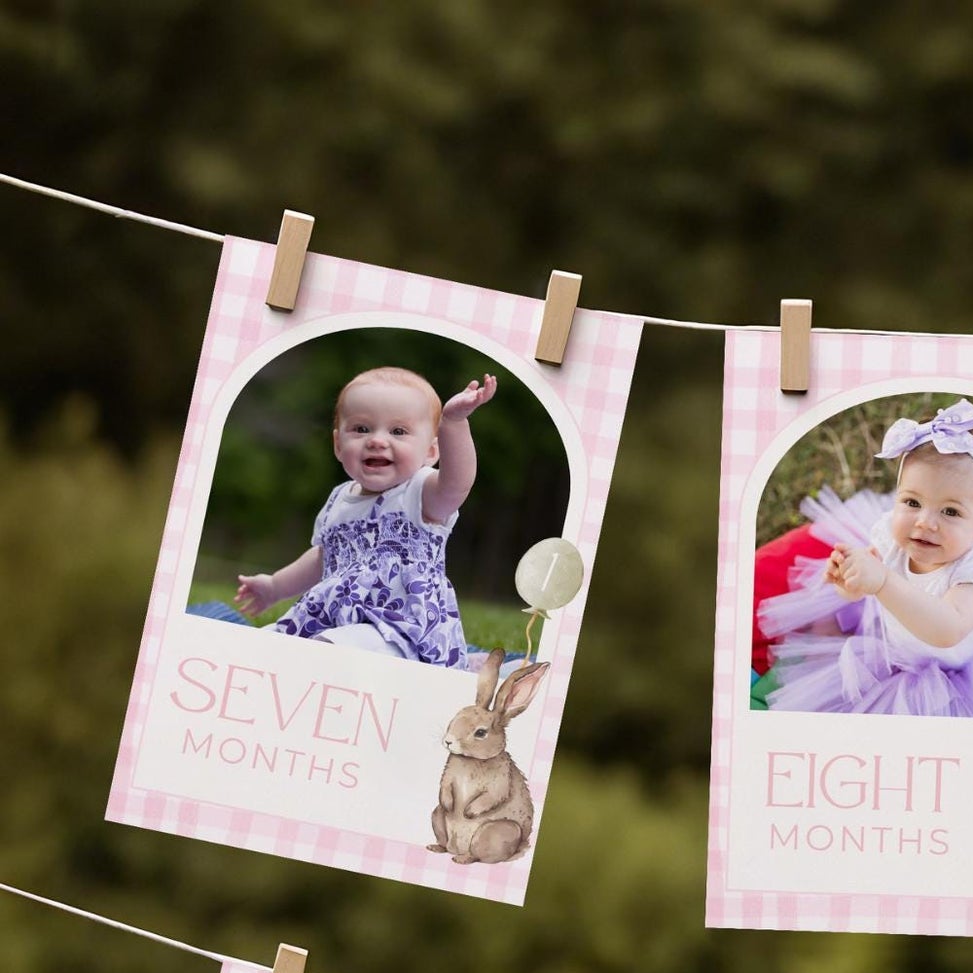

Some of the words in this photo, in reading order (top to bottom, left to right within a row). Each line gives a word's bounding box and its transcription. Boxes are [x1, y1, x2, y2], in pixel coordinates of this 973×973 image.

[540, 552, 558, 592] 1
[170, 657, 399, 752] SEVEN
[181, 728, 361, 789] MONTHS
[765, 752, 960, 812] EIGHT
[770, 825, 950, 855] MONTHS
